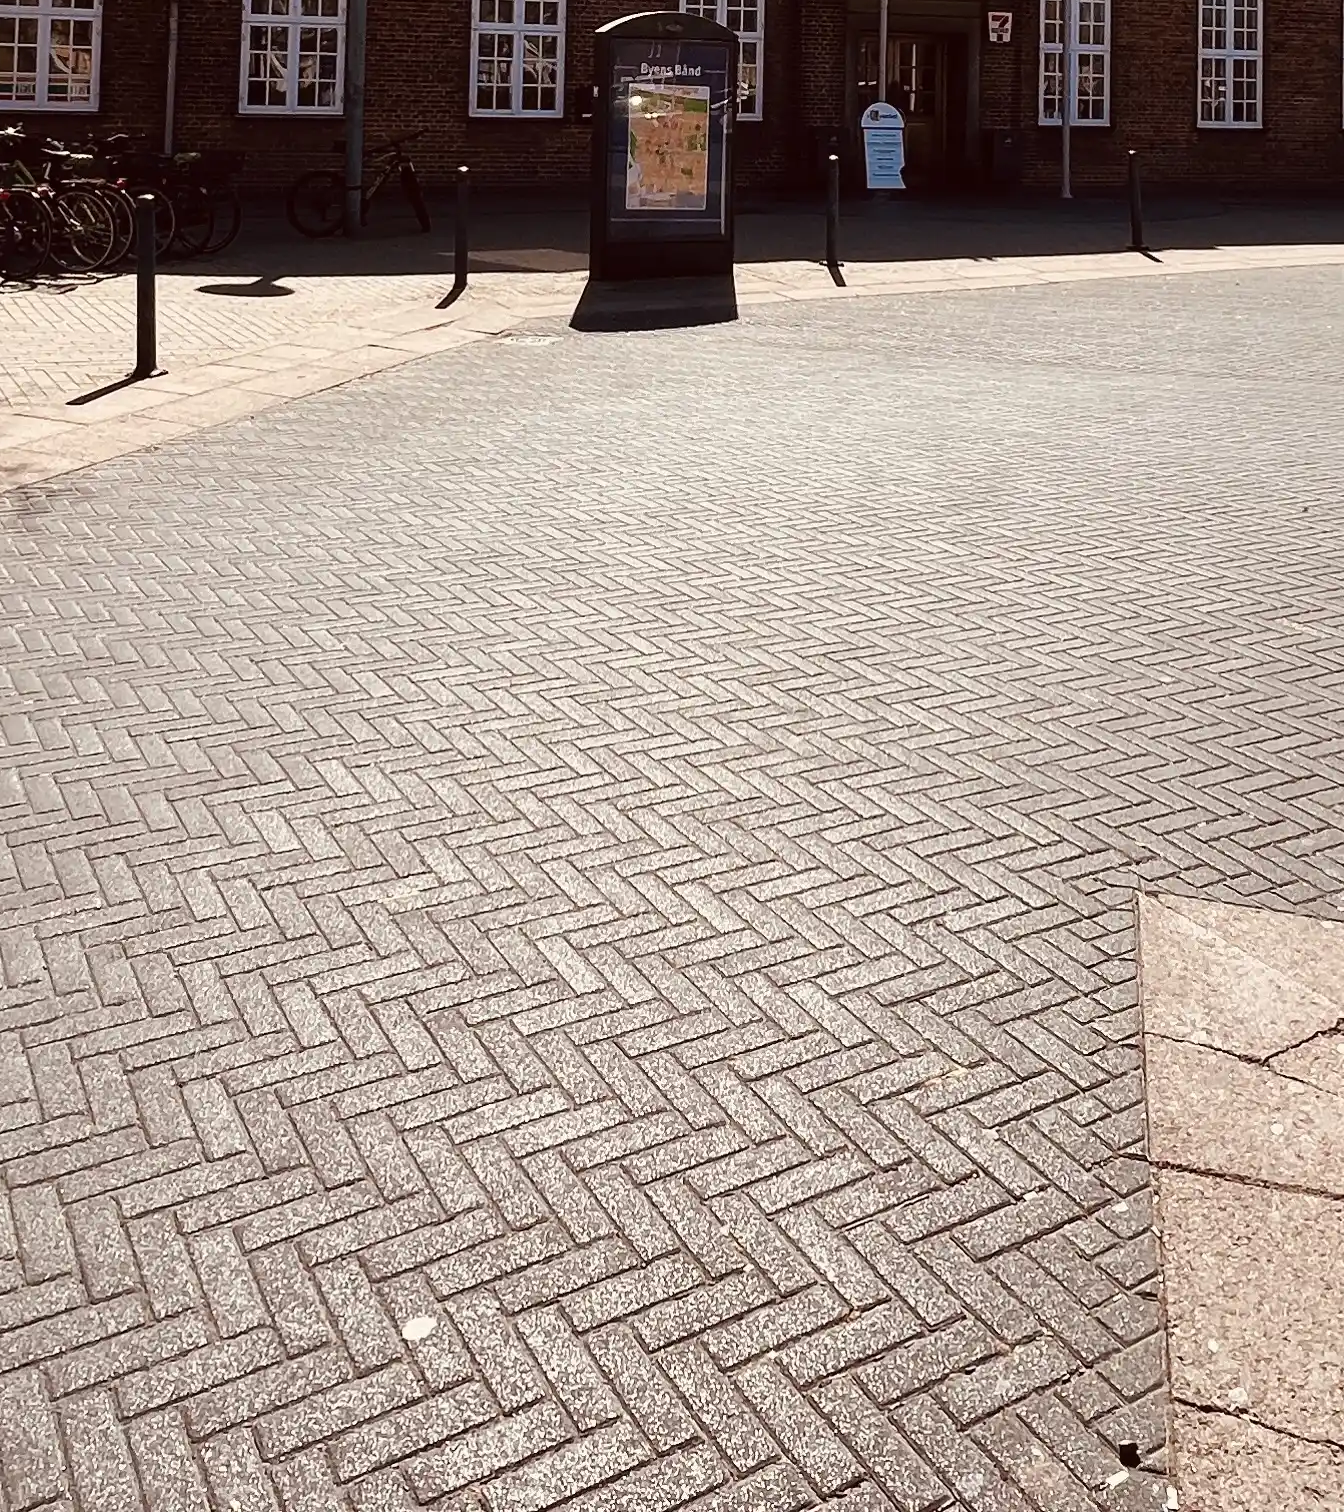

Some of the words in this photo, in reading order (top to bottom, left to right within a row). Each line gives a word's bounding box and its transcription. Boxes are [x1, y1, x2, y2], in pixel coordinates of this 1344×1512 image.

[992, 15, 1009, 41] 7
[640, 62, 673, 77] Byens
[674, 64, 701, 77] Bånd
